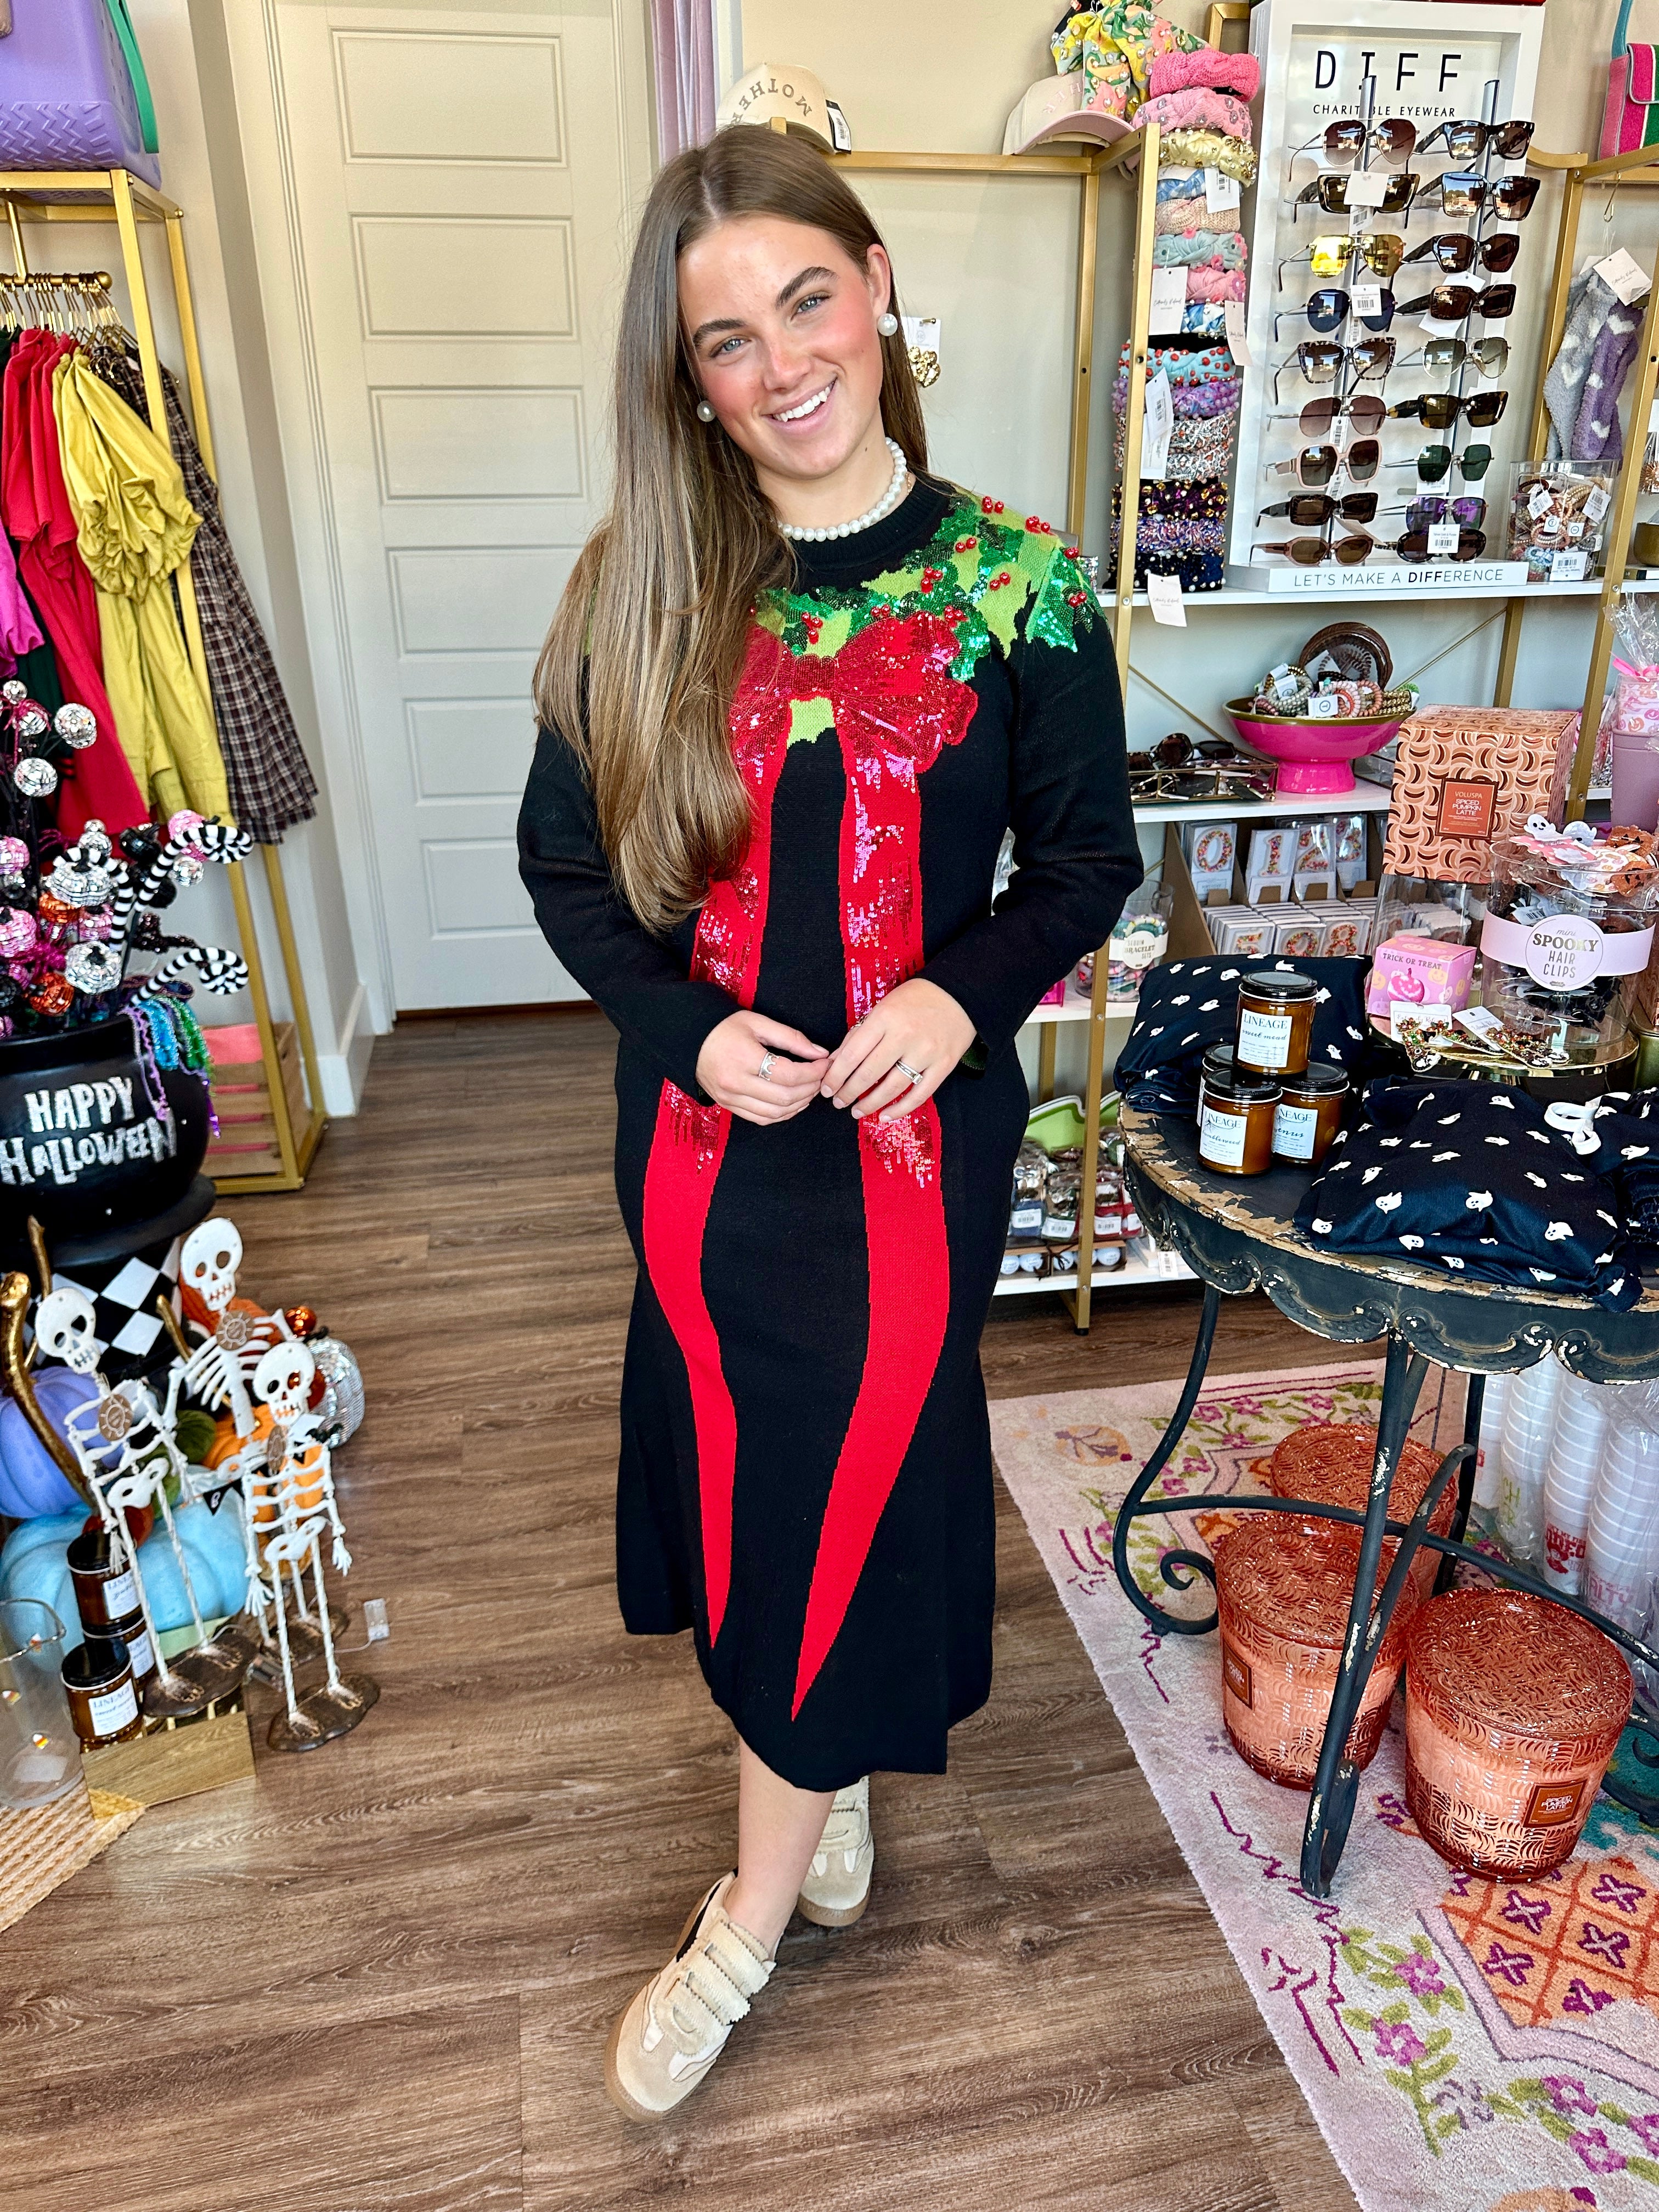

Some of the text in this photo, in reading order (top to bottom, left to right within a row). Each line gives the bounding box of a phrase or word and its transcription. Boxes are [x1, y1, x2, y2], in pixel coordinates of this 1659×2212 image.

[1315, 50, 1462, 92] DIFF
[731, 78, 812, 125] MOTHER
[1313, 104, 1455, 117] CHARITBLE EYEWEAR
[1294, 568, 1504, 587] LET'S MAKE A DIFFERENCE
[1454, 791, 1483, 799] VOLUSPA
[1452, 803, 1482, 811] PUMPKIN
[1124, 945, 1155, 953] BRACELET
[1532, 933, 1599, 952] SPOOKY
[1383, 953, 1404, 963] TRICK
[1418, 960, 1442, 970] TREAT
[1548, 950, 1576, 964] HAIR
[1543, 963, 1576, 978] CLIPS
[1244, 1013, 1288, 1029] LINEAGE
[24, 1076, 136, 1133] HAPPY
